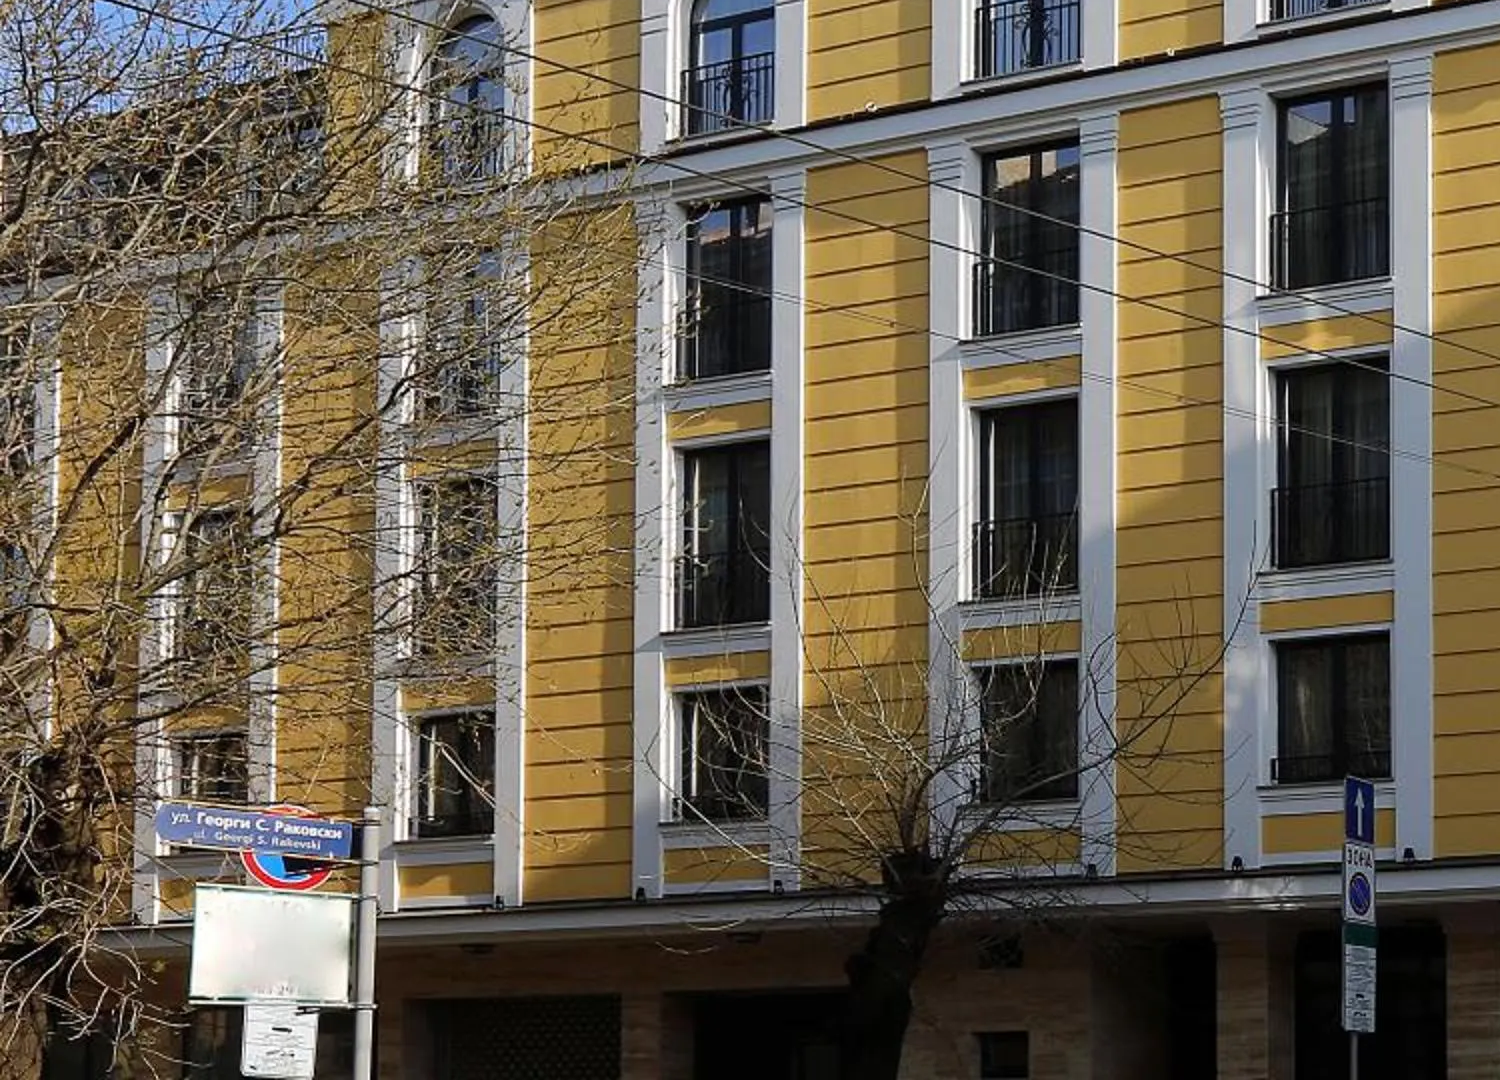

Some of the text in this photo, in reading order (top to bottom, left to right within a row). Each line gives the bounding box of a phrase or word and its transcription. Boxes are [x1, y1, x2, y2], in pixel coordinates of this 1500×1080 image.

[197, 812, 250, 829] Георги
[275, 820, 342, 839] Раковски
[215, 832, 254, 845] Georgi
